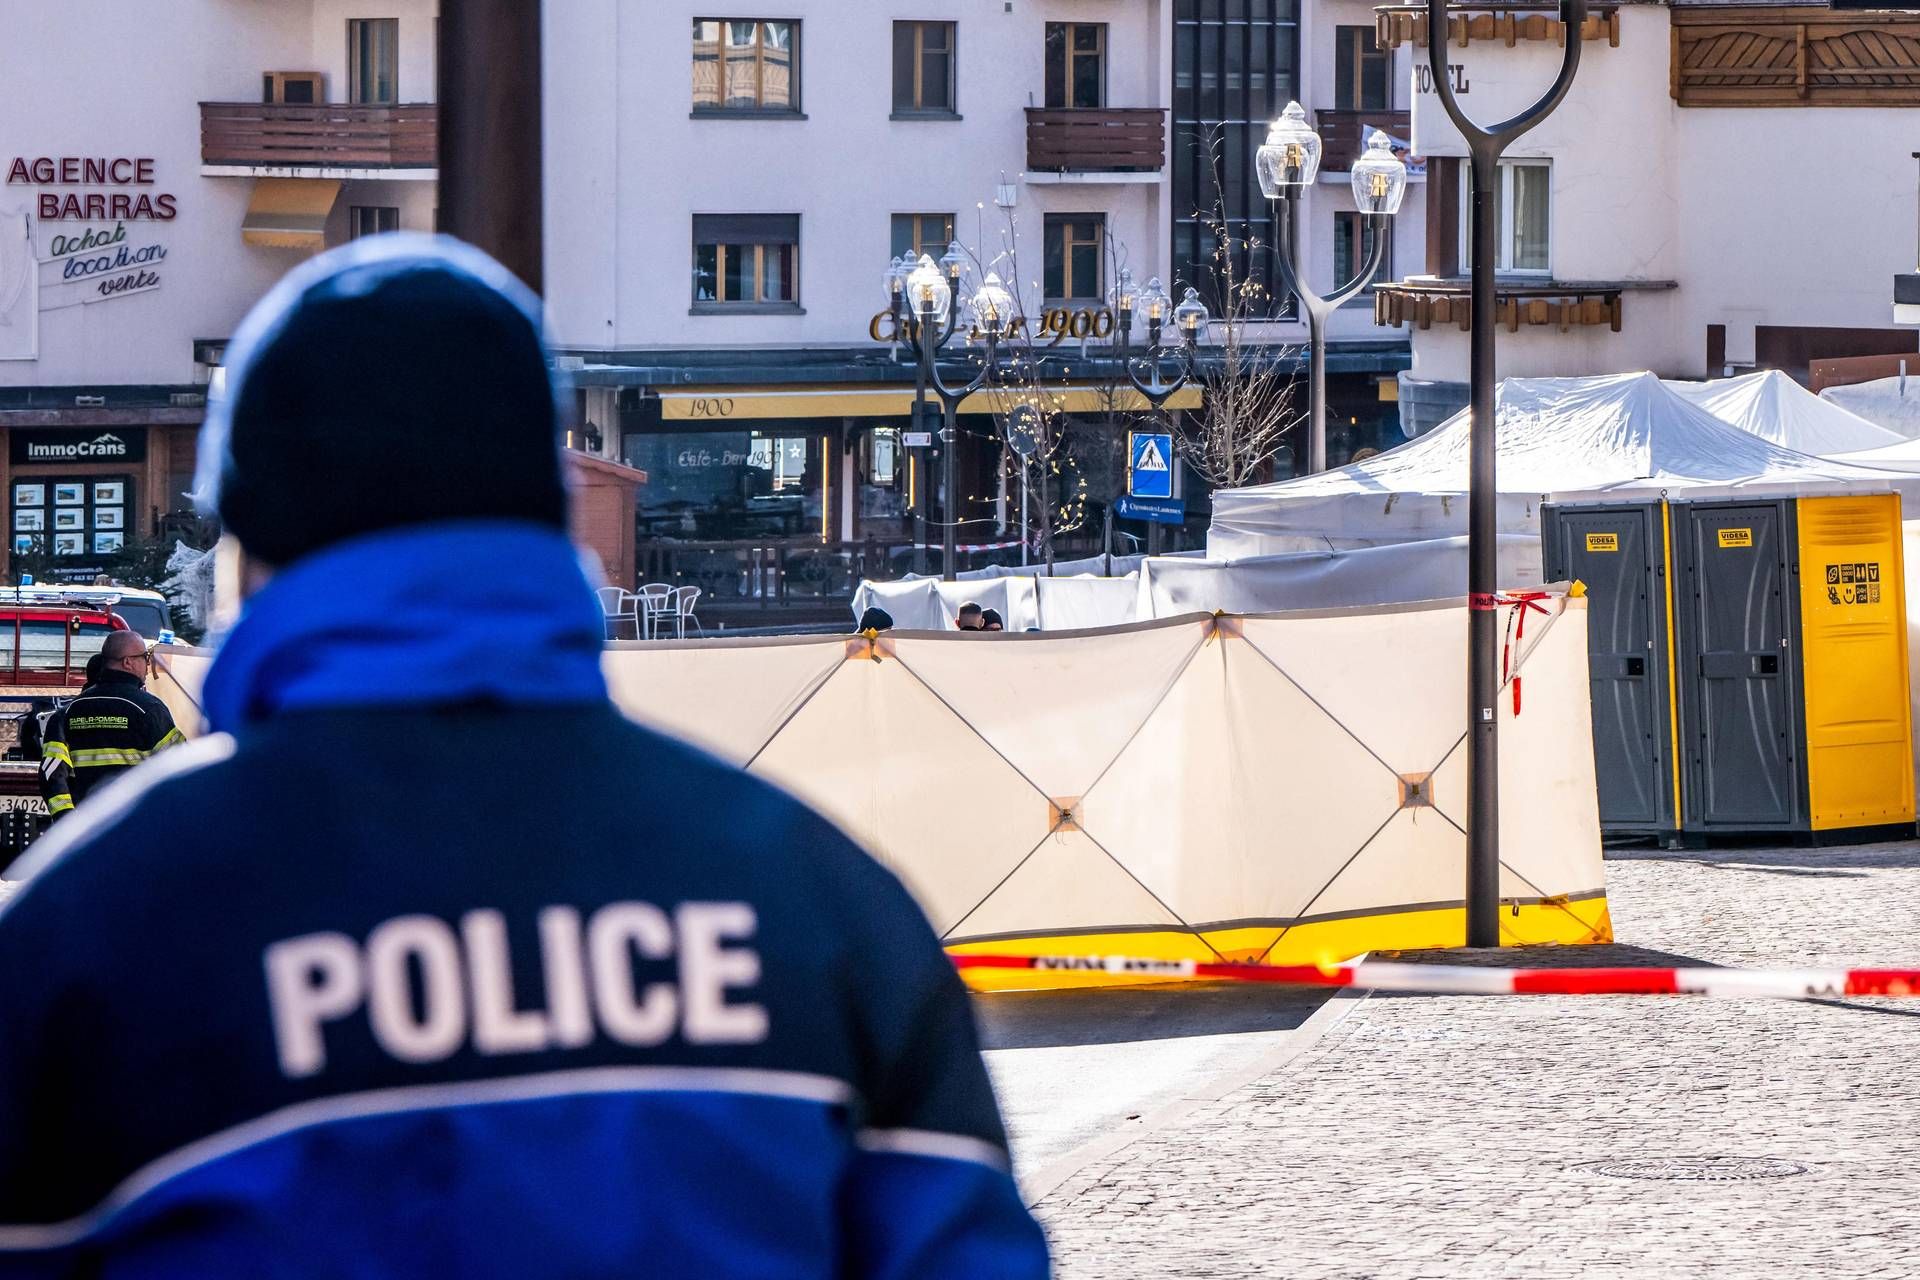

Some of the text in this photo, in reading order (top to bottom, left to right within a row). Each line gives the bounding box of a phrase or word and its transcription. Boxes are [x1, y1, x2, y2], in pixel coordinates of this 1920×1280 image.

[1415, 64, 1469, 93] HOL
[7, 157, 155, 184] AGENCE
[38, 193, 177, 220] BARRAS
[51, 221, 126, 256] achat
[63, 244, 167, 279] location
[98, 270, 160, 295] vente
[1040, 306, 1115, 347] 1900
[688, 399, 734, 417] 1900
[28, 442, 126, 456] ImmoCrans
[678, 448, 712, 467] Café
[720, 450, 746, 466] Bar
[749, 450, 782, 465] 1900
[264, 901, 770, 1077] POLICE
